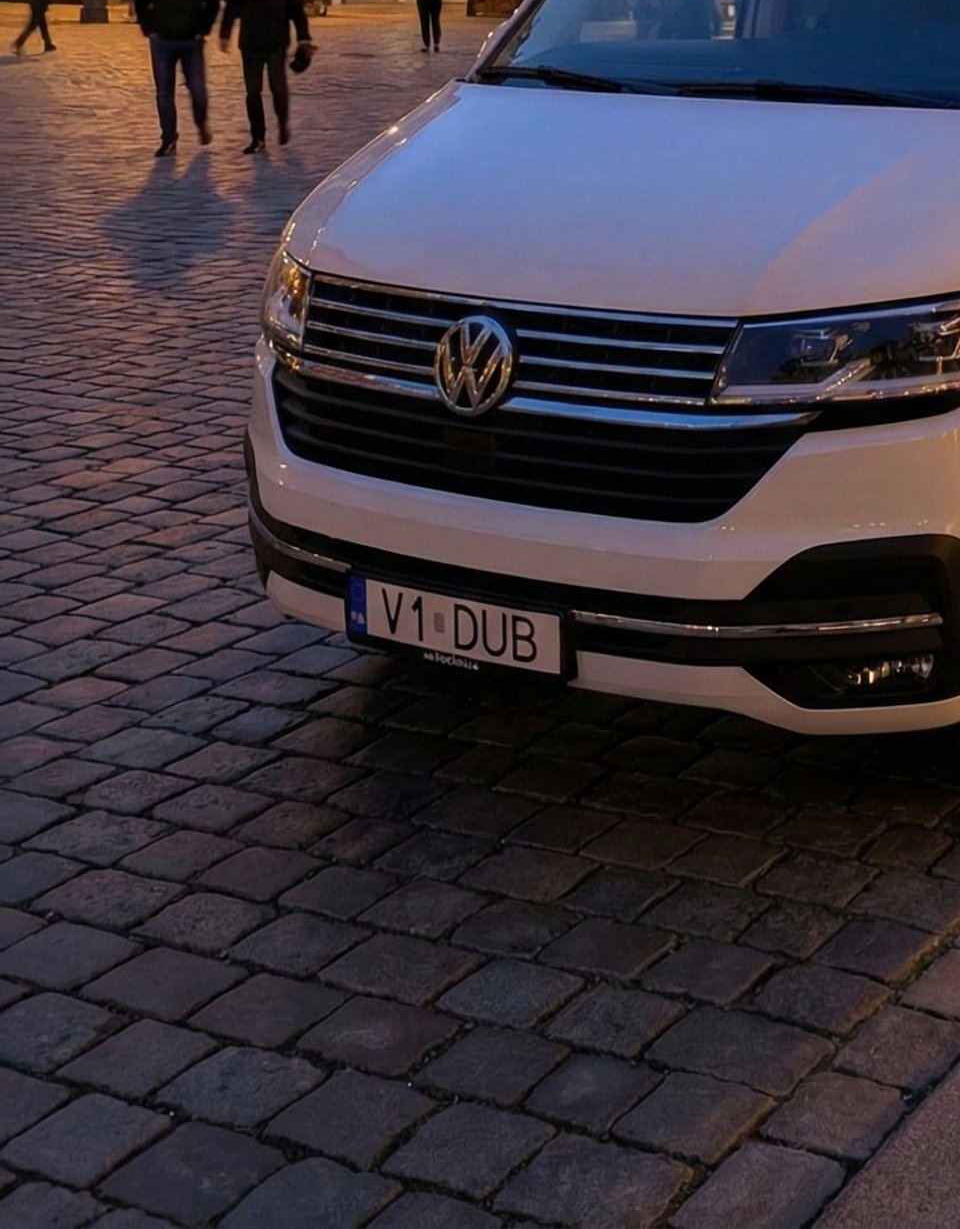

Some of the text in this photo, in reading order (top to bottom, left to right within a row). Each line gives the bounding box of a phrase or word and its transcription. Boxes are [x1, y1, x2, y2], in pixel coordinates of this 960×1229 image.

[436, 316, 511, 414] VW
[381, 587, 538, 663] V1 DUB
